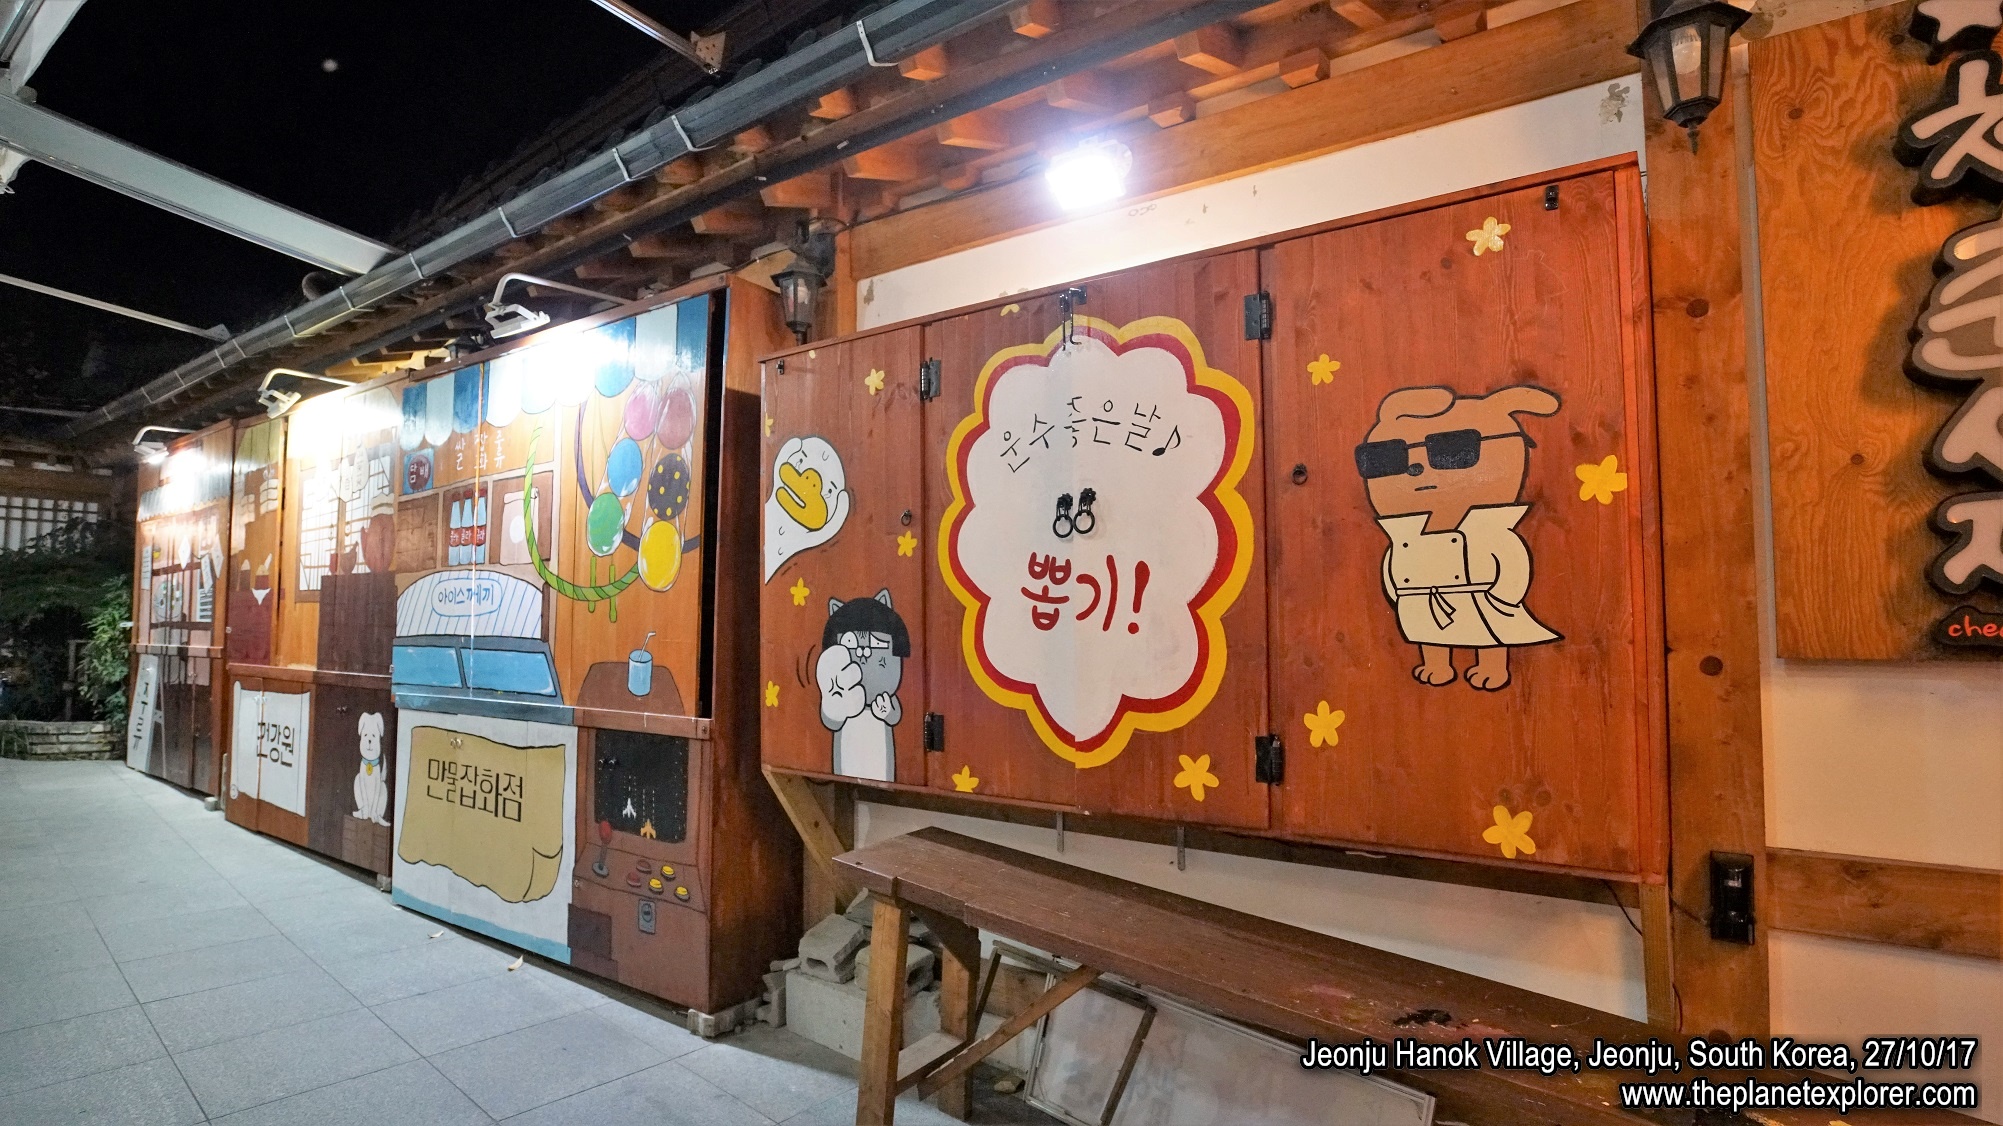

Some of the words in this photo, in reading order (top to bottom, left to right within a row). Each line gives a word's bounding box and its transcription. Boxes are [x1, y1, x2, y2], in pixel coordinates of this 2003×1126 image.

[494, 430, 506, 469] 주류
[410, 463, 429, 484] 담배
[438, 584, 494, 606] 아이스께끼
[1020, 551, 1151, 635] 뽑기!
[1948, 614, 2003, 638] che
[426, 758, 523, 823] 만물잡화점
